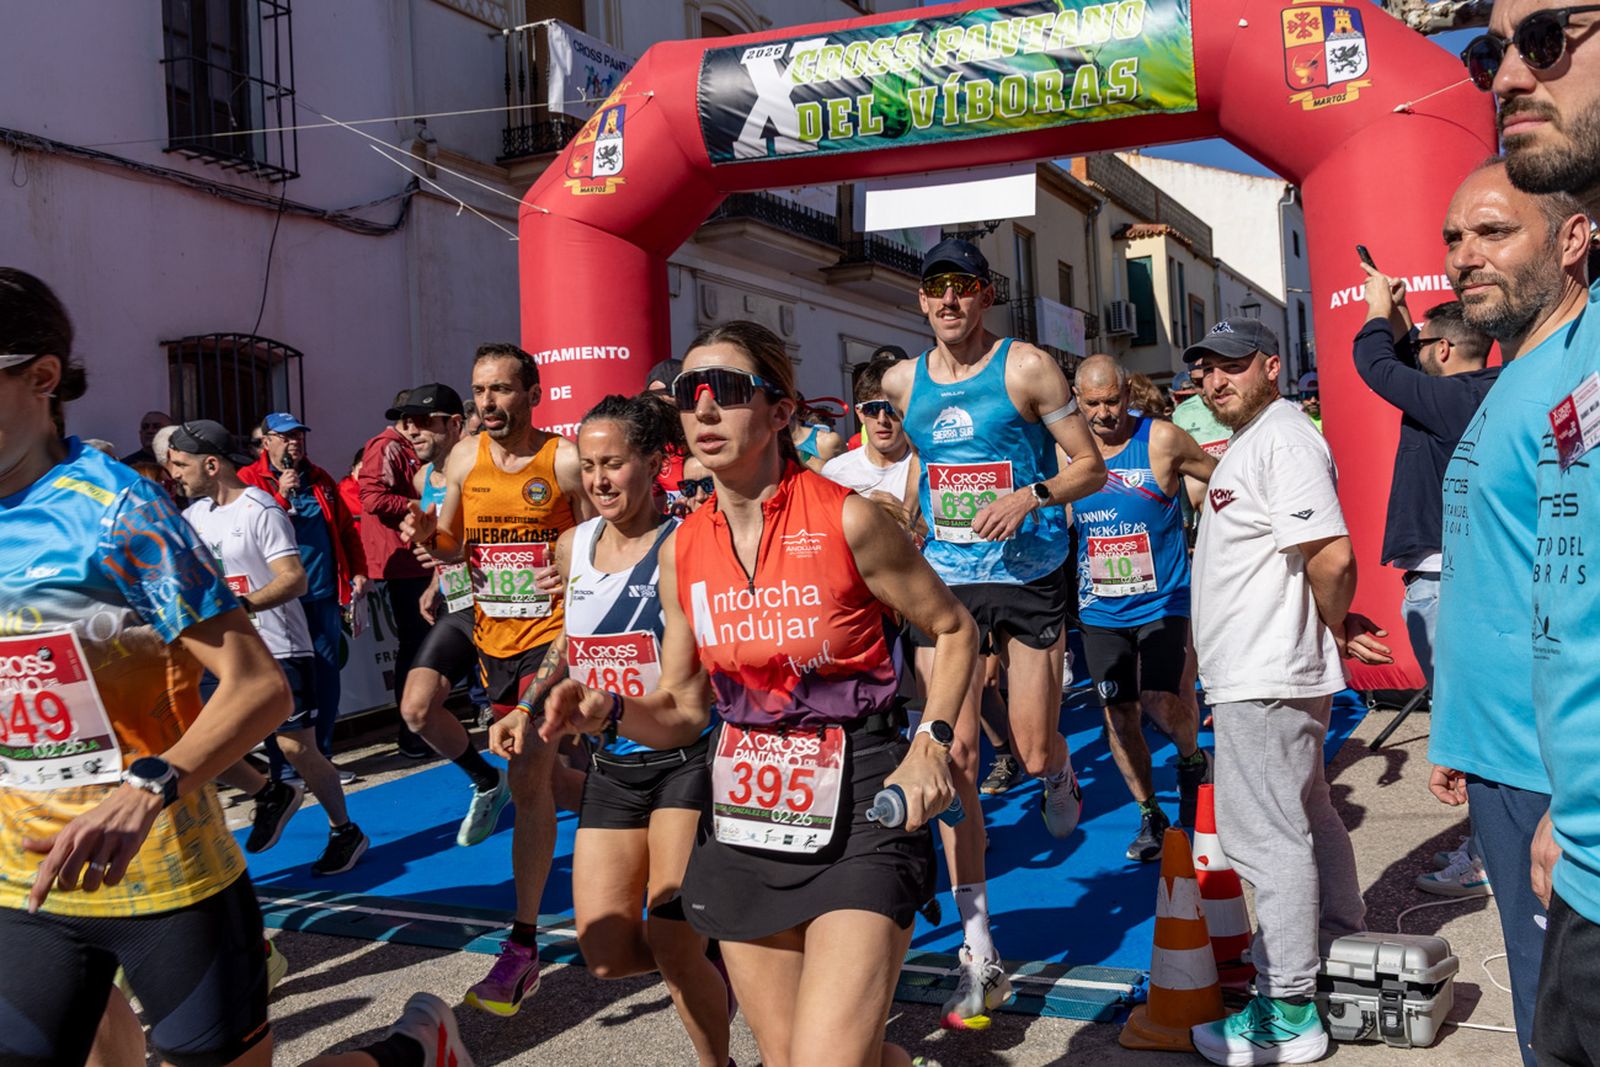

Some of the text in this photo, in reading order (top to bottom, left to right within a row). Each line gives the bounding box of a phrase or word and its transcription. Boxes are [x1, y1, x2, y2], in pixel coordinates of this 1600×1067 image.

[573, 39, 603, 64] CROSS
[746, 46, 782, 60] 2026
[732, 1, 1146, 160] X CROSS PANTANO
[795, 56, 1139, 143] DEL VÍBORAS
[1313, 93, 1347, 108] MARTOS
[550, 385, 572, 401] DE
[932, 428, 958, 441] SIERRA
[959, 427, 974, 438] SUR
[937, 468, 950, 484] X
[951, 471, 997, 485] CROSS
[938, 483, 987, 494] PANTANO
[480, 547, 535, 563] X CROSS
[1093, 540, 1138, 552] X CROSS
[1558, 536, 1585, 557] DEL
[480, 562, 525, 571] PANTANO
[1104, 556, 1132, 578] 10
[487, 569, 535, 595] 182
[572, 640, 589, 658] X
[588, 643, 639, 659] CROSS
[783, 640, 836, 678] trail
[576, 657, 628, 670] PANTANO
[586, 667, 645, 698] 486
[737, 731, 821, 756] X CROSS
[732, 748, 802, 769] PANTANO
[728, 761, 815, 813] 395
